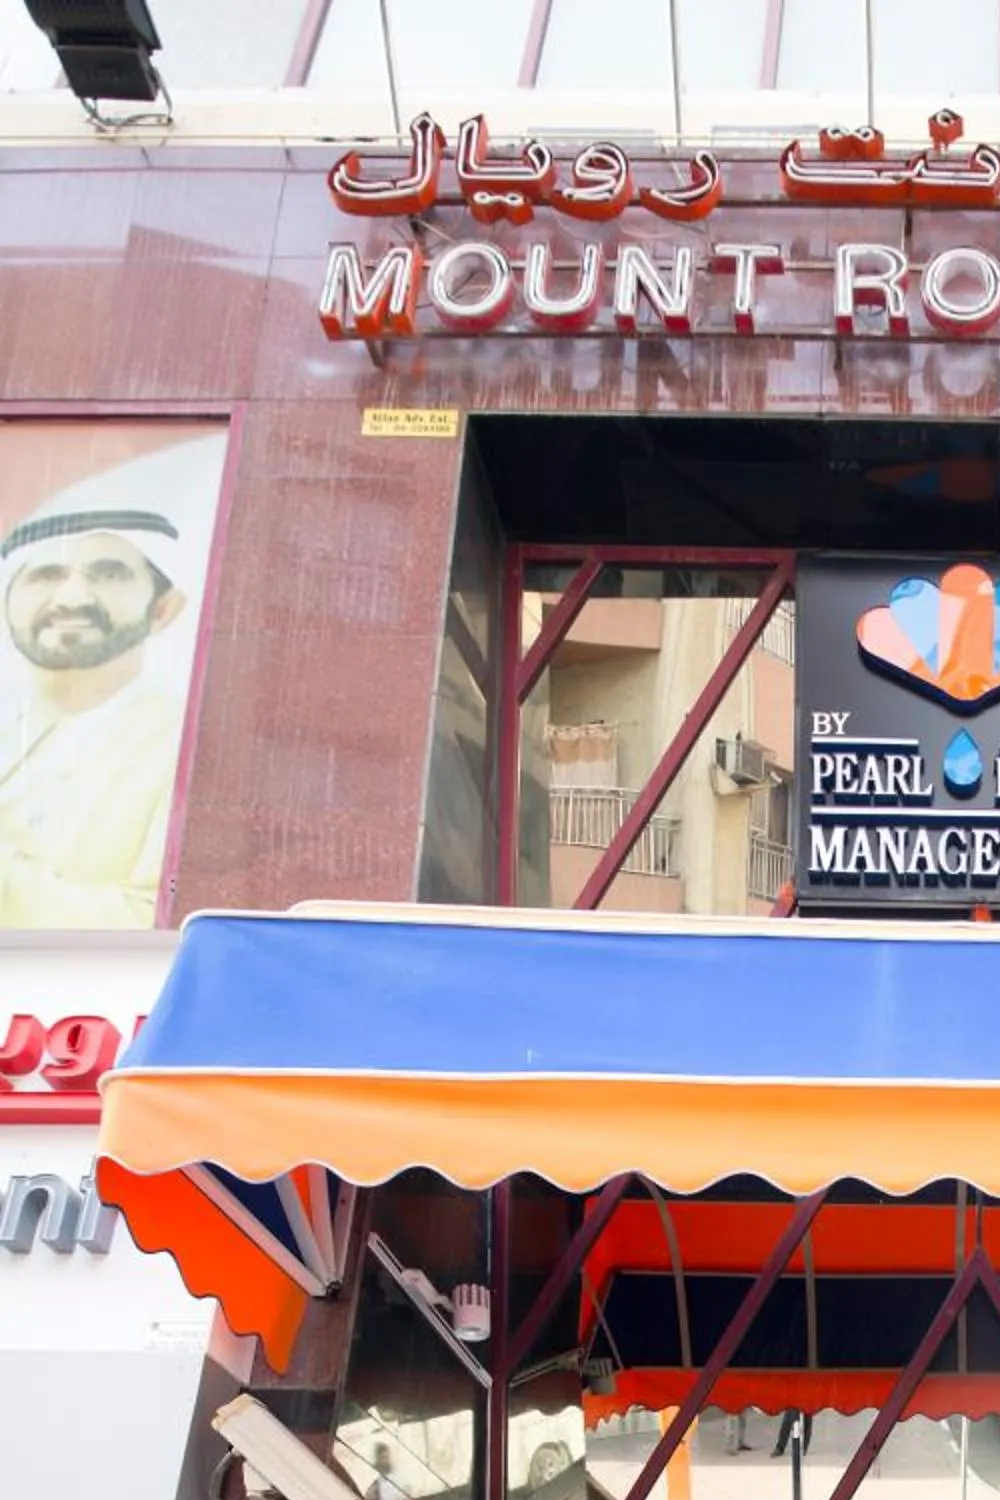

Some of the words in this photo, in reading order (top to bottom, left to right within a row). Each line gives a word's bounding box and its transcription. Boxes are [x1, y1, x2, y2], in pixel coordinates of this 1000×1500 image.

[328, 112, 724, 227] رويال
[319, 240, 786, 339] MOUNT
[811, 712, 850, 735] BY
[811, 753, 933, 798] PEARL
